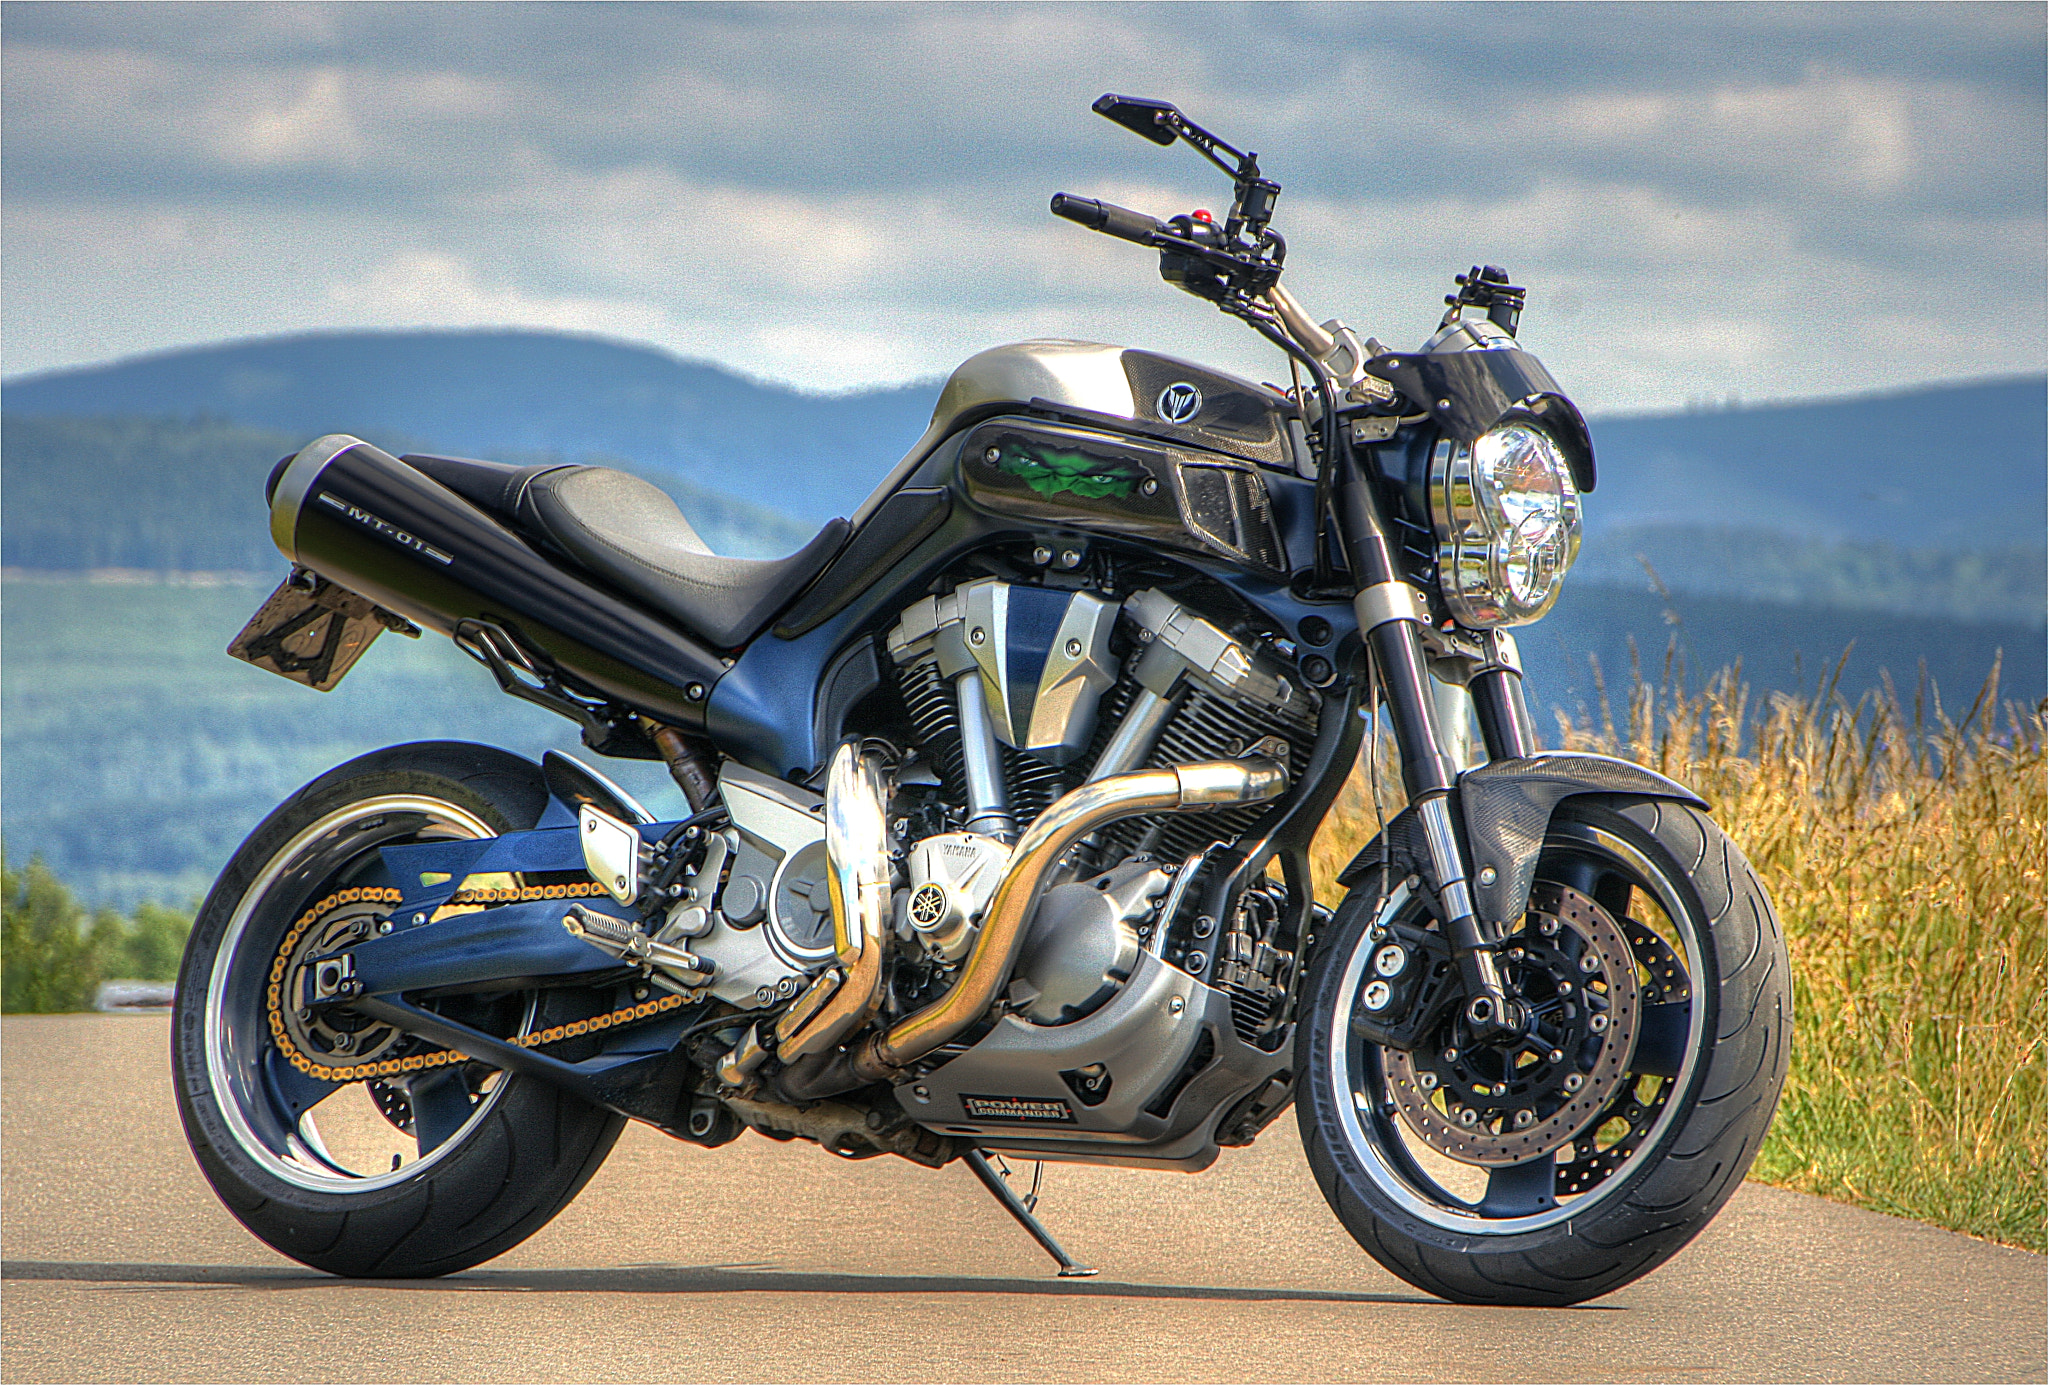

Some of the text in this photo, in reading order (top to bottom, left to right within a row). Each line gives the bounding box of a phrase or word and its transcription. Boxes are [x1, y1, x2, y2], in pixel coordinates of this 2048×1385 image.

[943, 843, 976, 858] YAMAHA
[974, 1099, 1060, 1111] POWER
[1312, 1027, 1358, 1175] MICHELIN
[977, 1107, 1060, 1119] COMMANDER
